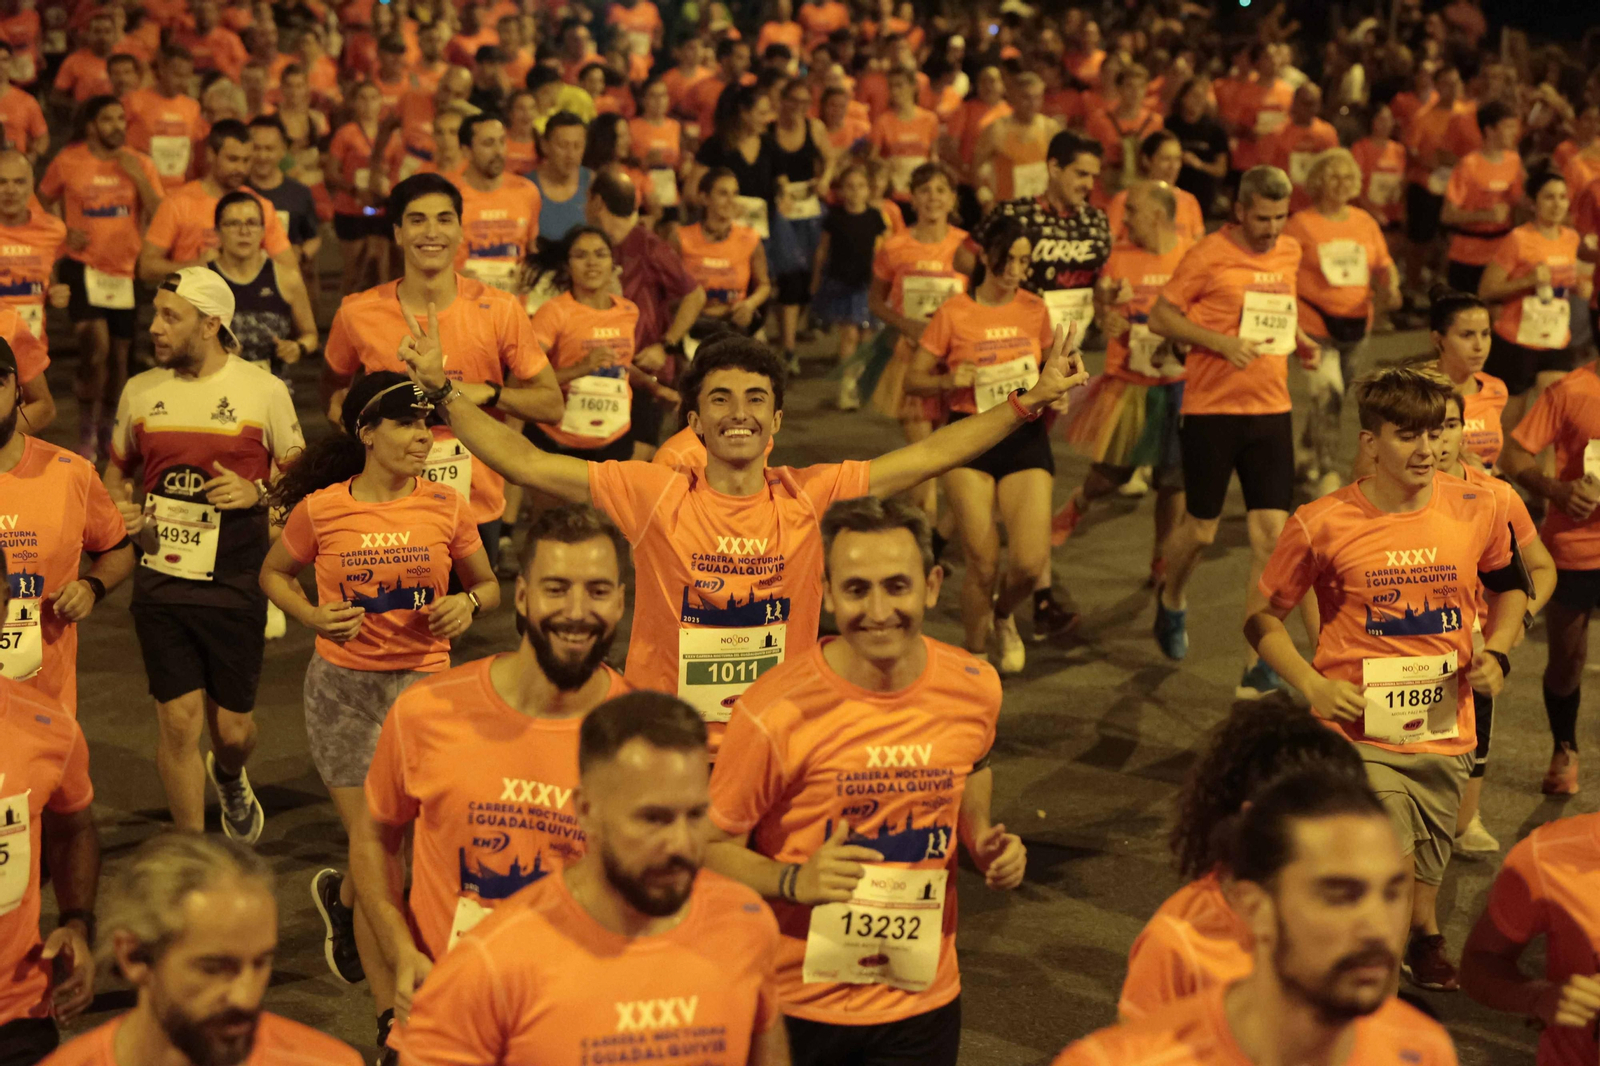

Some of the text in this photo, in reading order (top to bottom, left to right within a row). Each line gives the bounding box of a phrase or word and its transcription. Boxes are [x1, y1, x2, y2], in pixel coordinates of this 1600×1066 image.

[1031, 238, 1097, 263] CORRE
[581, 398, 619, 413] 16078
[153, 525, 202, 546] 14934
[361, 531, 410, 548] XXXV
[340, 546, 429, 558] CARRERA NOCTURNA
[716, 536, 768, 555] XXXV
[347, 554, 430, 567] GUADALQUIVIR
[691, 552, 785, 565] CARRERA NOCTURNA
[1385, 547, 1437, 567] XXXV
[697, 562, 785, 575] GUADALQUIVIR
[1365, 564, 1457, 578] CARRERA NOCTURNA
[1373, 573, 1458, 587] GUADALQUIVIR
[708, 661, 758, 682] 1011
[1385, 686, 1444, 708] 11888
[866, 744, 932, 768] XXXV
[836, 768, 954, 782] CARRERA NOCTURNA
[500, 777, 572, 810] XXXV
[845, 778, 954, 796] GUADALQUIVIR
[469, 801, 523, 815] CARRERA
[476, 813, 587, 842] GUADALQUIVIR
[841, 911, 921, 940] 13232
[615, 995, 698, 1031] XXXV
